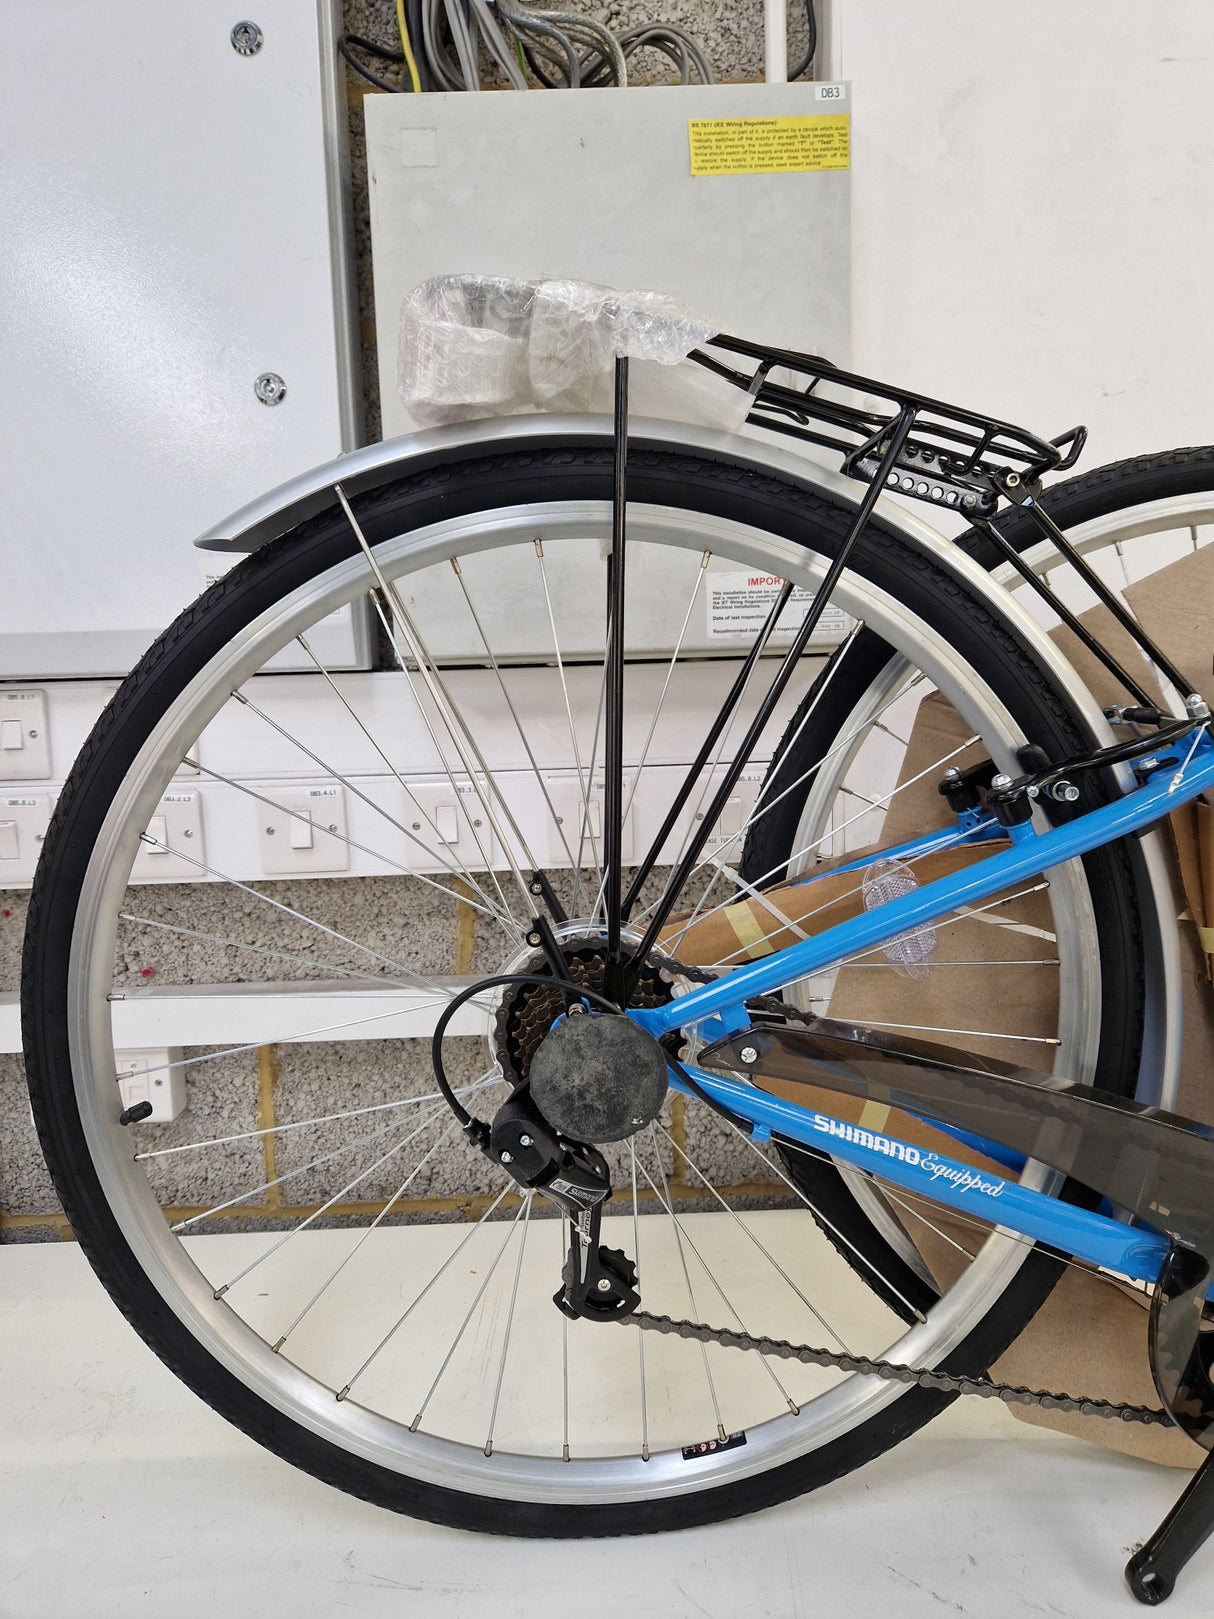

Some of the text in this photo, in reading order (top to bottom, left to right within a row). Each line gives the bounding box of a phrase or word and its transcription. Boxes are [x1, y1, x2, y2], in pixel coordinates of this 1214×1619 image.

[820, 87, 840, 98] DB3
[747, 576, 782, 586] IMPOR
[813, 1114, 1006, 1198] SHIMANO Equipped
[569, 1187, 598, 1203] SHIMANO
